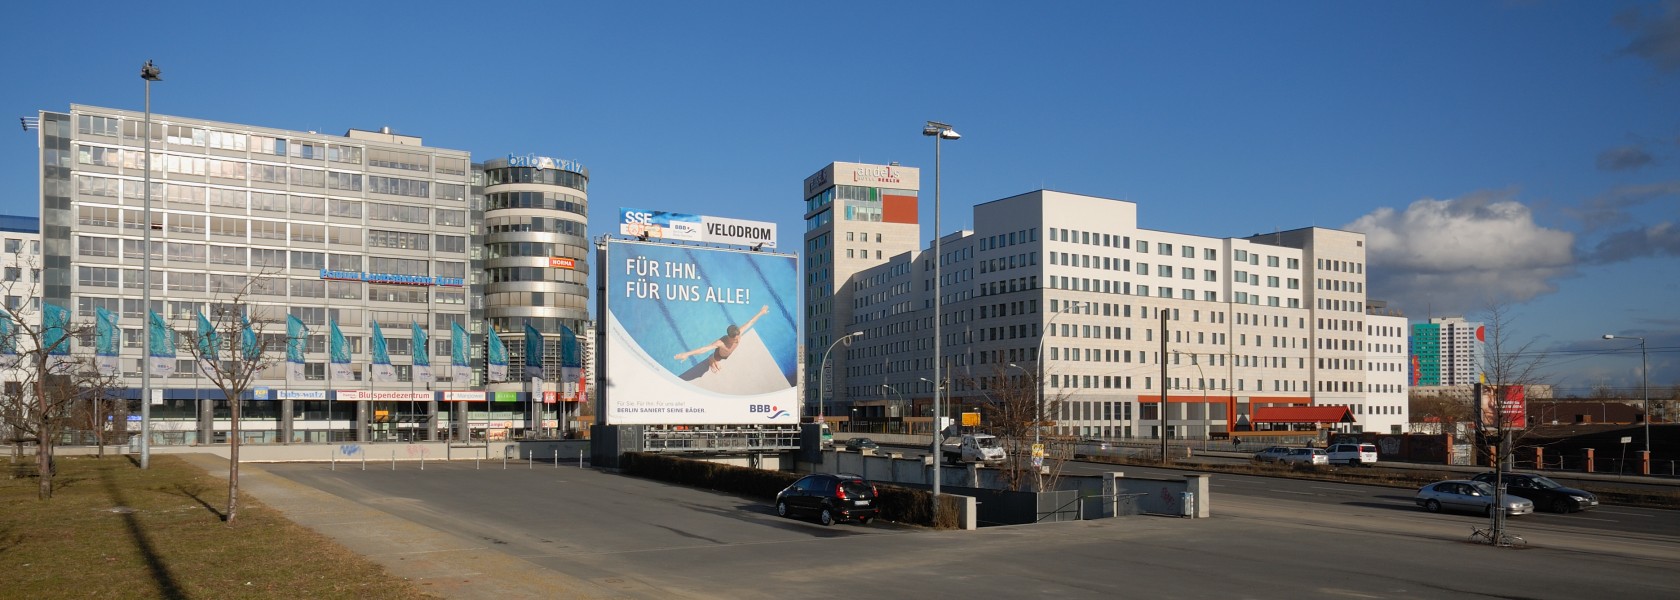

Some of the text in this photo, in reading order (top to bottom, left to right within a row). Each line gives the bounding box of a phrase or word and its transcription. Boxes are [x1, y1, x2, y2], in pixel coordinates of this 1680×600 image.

[625, 211, 653, 226] SSE
[706, 222, 771, 241] VELODROM
[552, 259, 573, 267] NORMA
[626, 256, 701, 280] FÜR IHN.
[626, 278, 750, 305] FÜR UNS ALLE!
[358, 391, 430, 400] Blutspendezentrum
[750, 404, 771, 413] BBB
